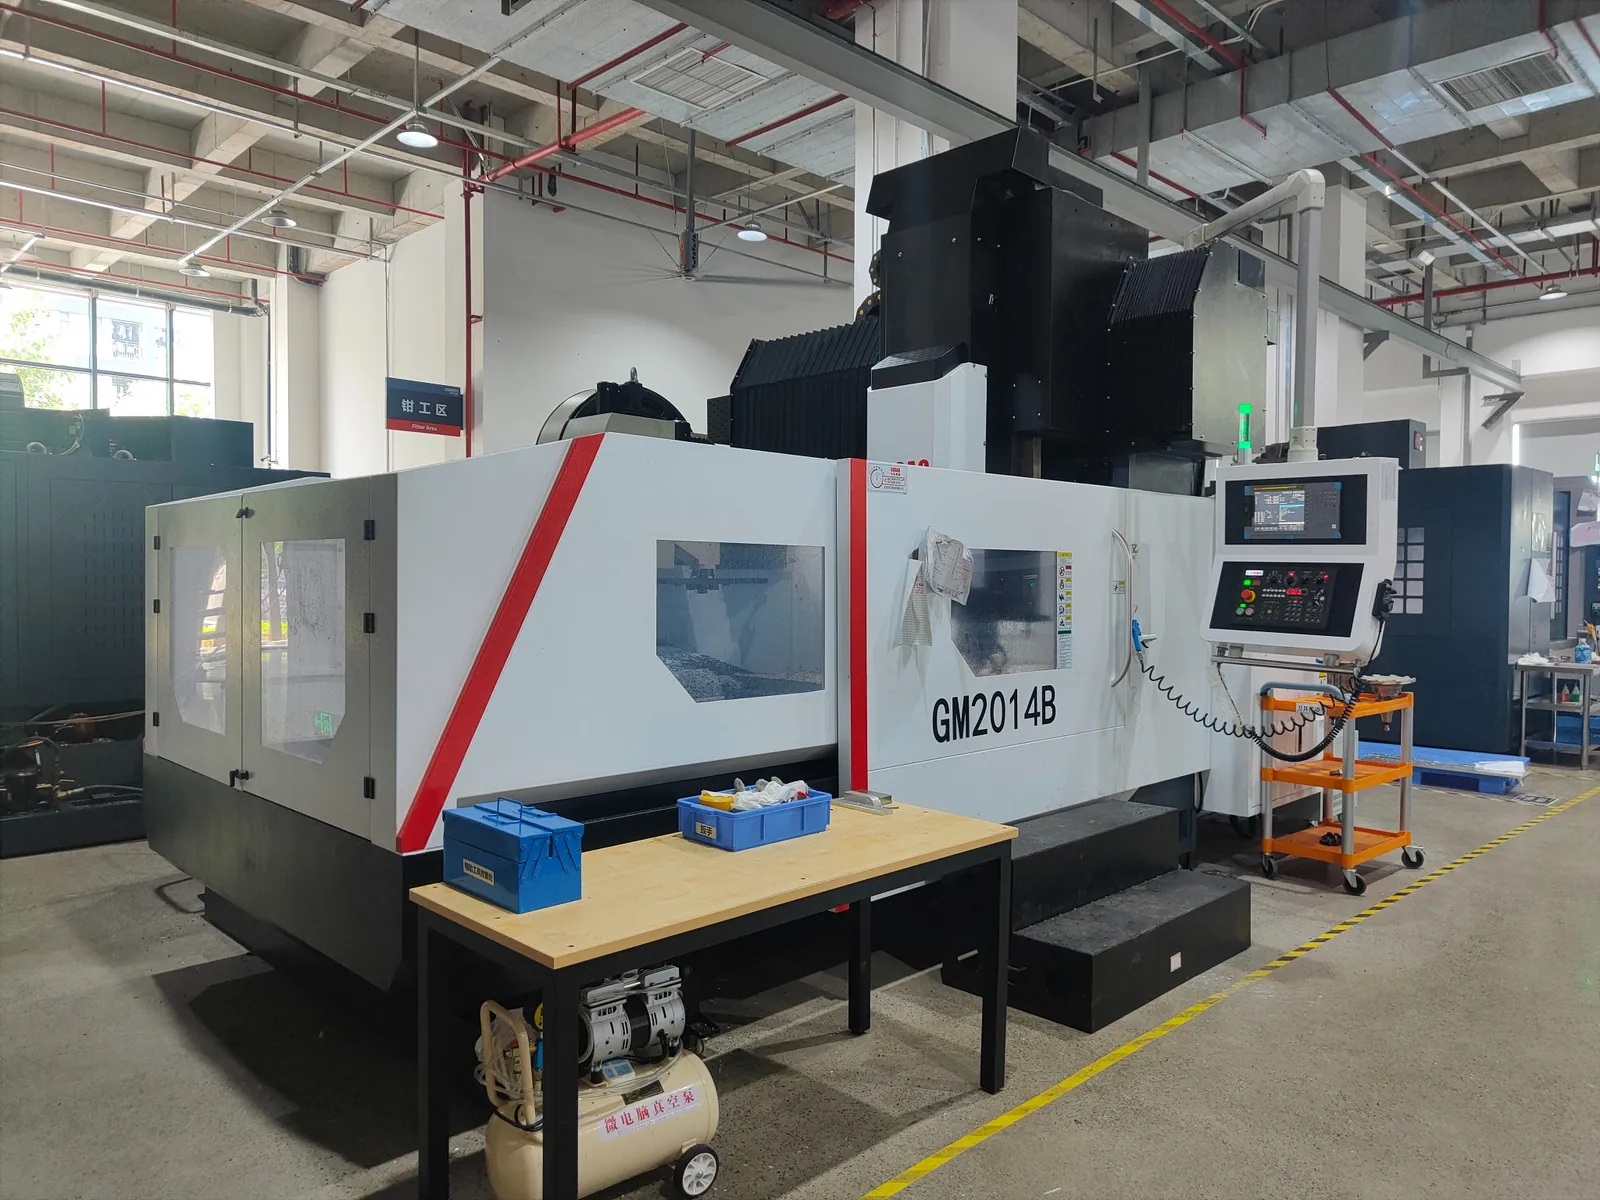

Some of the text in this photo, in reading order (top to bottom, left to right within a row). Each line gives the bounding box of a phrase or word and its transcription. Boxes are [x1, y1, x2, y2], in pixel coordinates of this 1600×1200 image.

[401, 398, 447, 416] 钳工区
[932, 684, 1056, 743] GM2014B
[700, 824, 713, 836] 扳手
[604, 1089, 694, 1133] 微电脑真空泵
